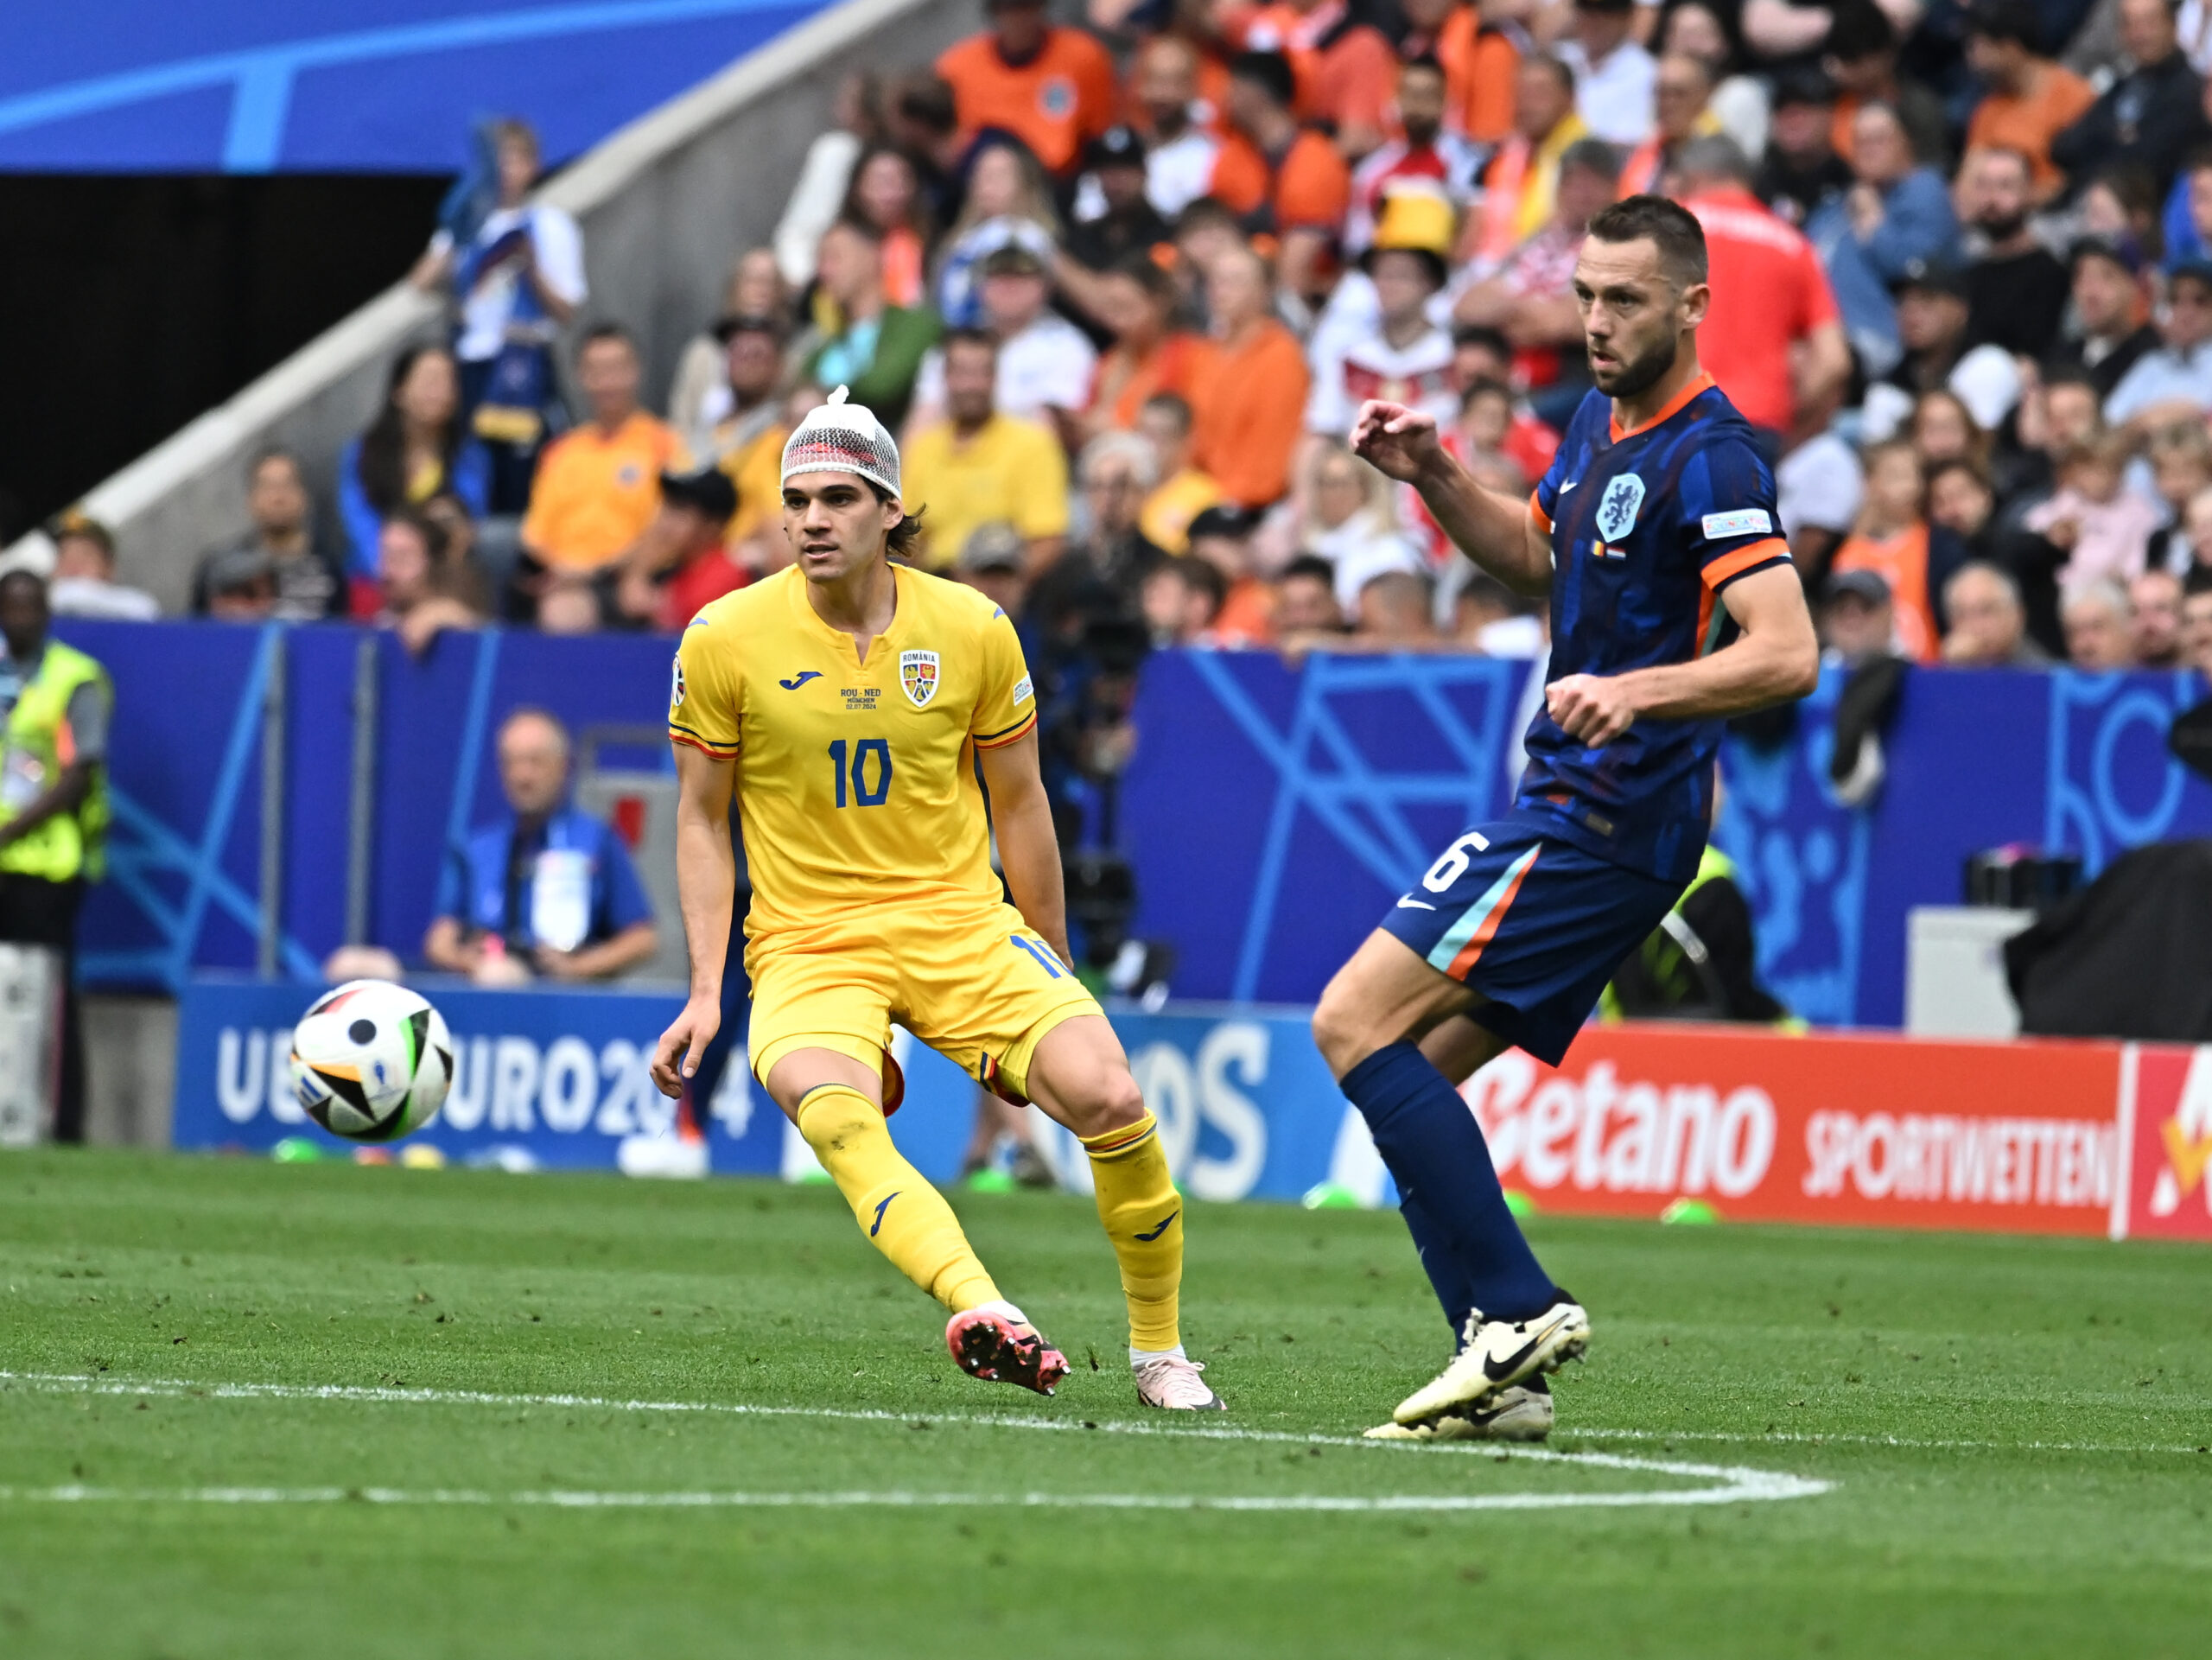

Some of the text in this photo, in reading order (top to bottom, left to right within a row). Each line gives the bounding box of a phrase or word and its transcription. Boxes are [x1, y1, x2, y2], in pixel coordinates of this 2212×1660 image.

[841, 689, 858, 697] ROU
[864, 689, 881, 697] NED
[828, 739, 893, 809] 10
[1422, 831, 1491, 893] 6
[1802, 1110, 2120, 1207] SPORTWETTEN
